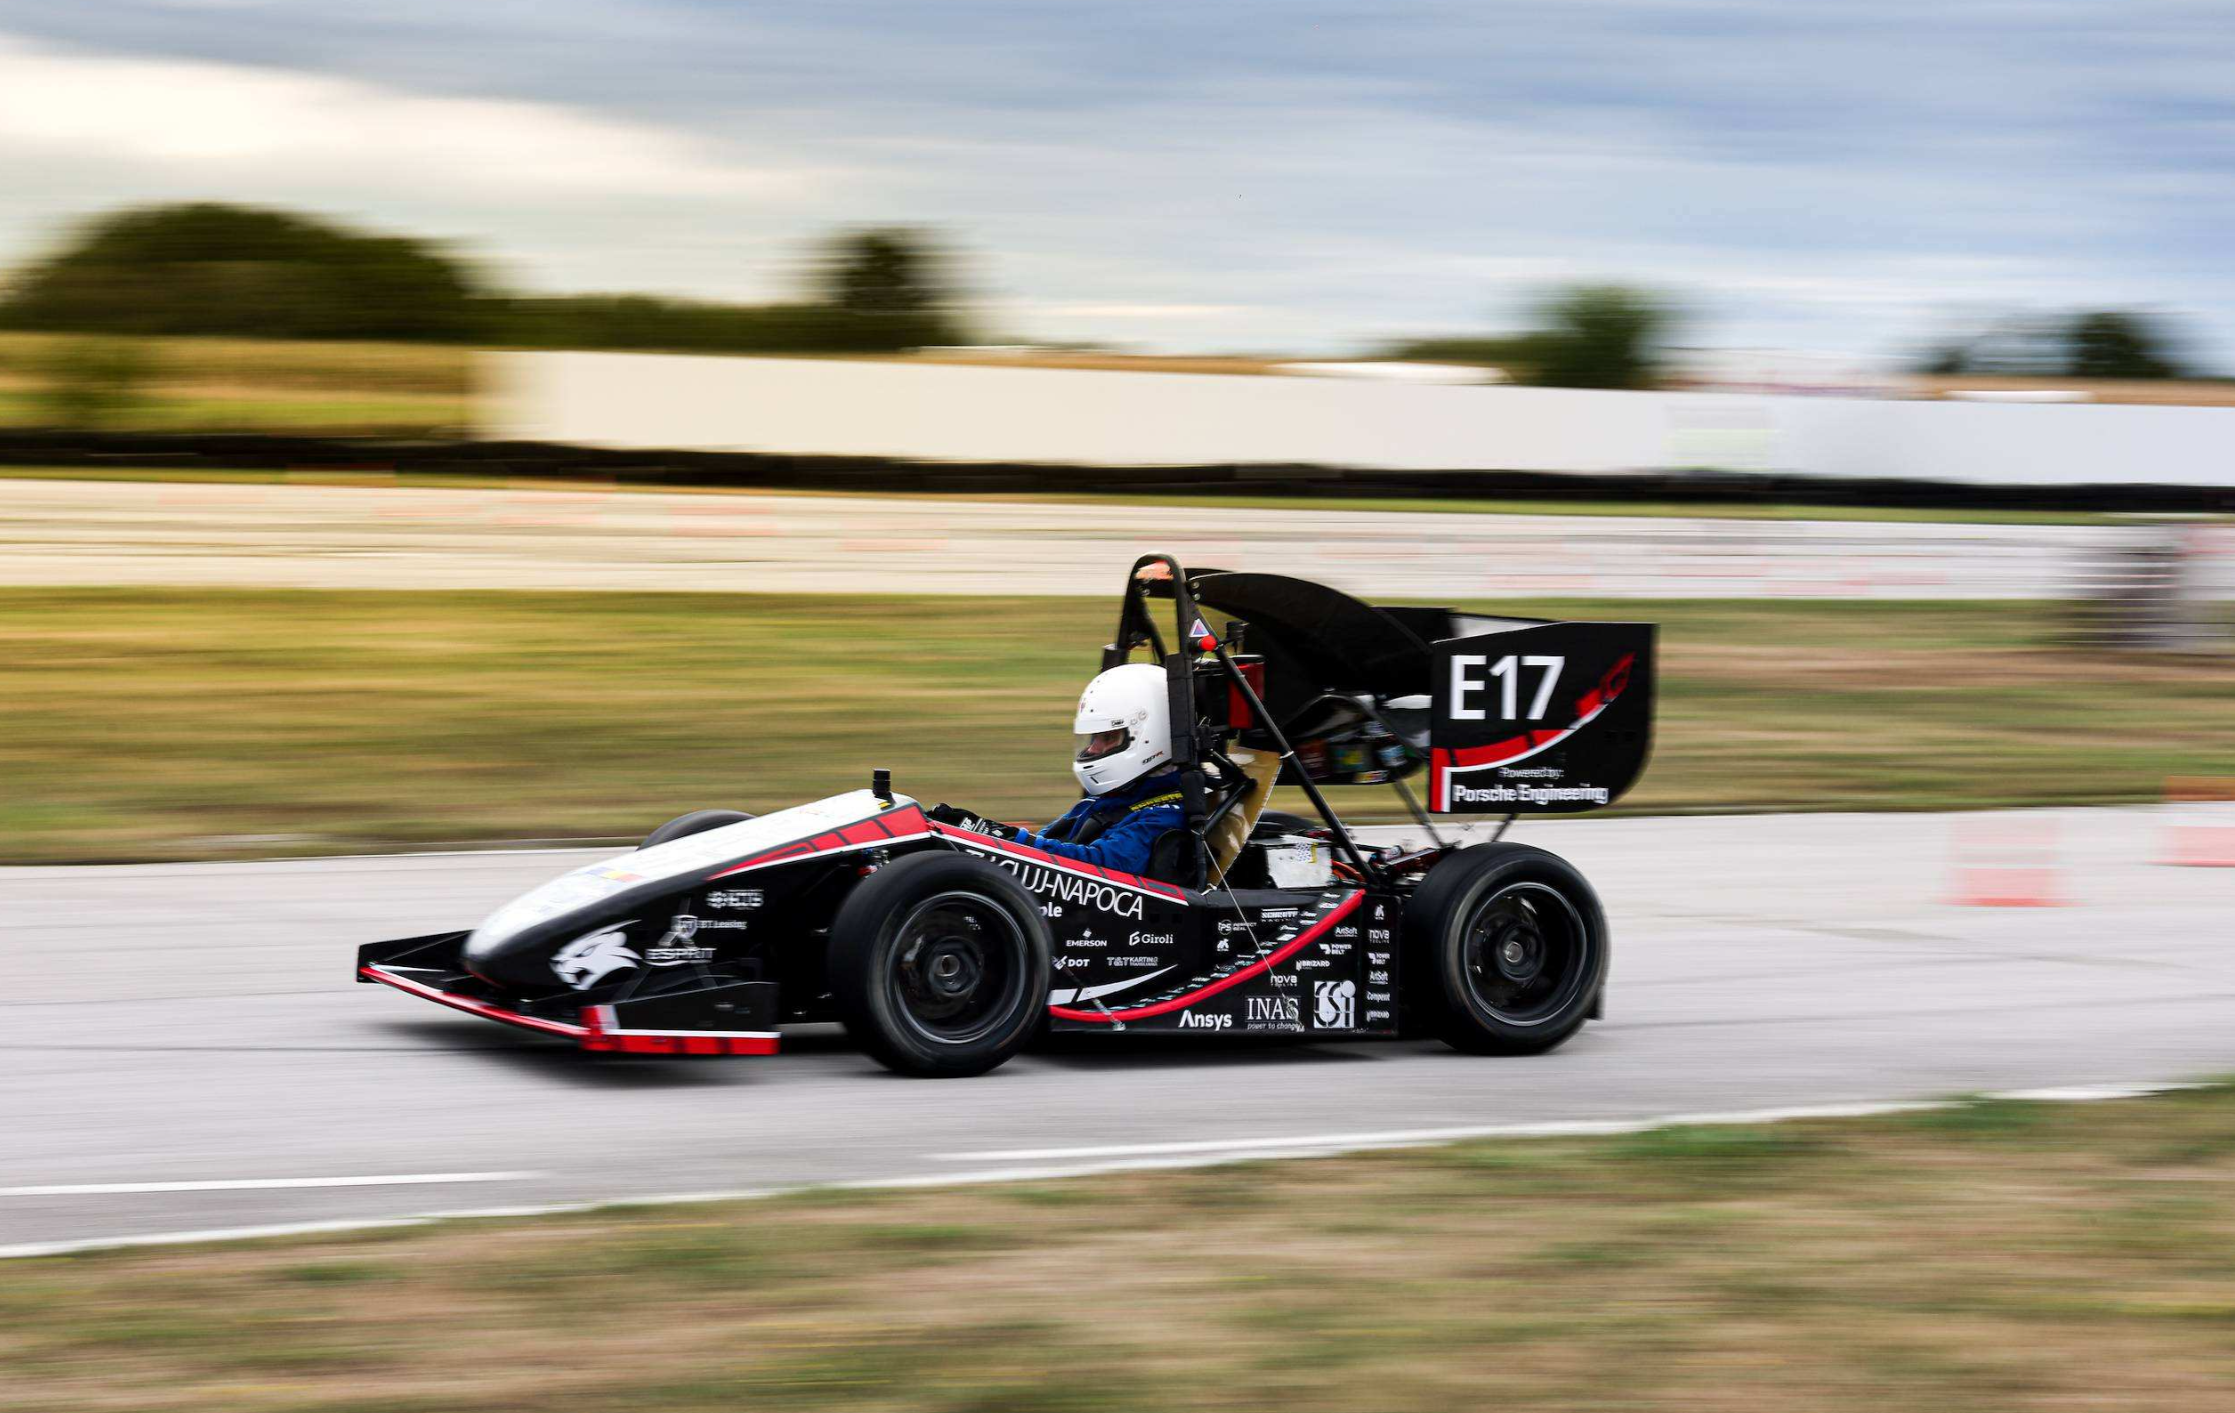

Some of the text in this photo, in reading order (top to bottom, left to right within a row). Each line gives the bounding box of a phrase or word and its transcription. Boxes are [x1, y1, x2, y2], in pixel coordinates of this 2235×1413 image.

[1450, 655, 1565, 720] E17
[1453, 783, 1609, 805] Porsche Engineering
[1141, 934, 1174, 944] Giroli
[1369, 929, 1390, 939] nova
[1068, 958, 1090, 967] DOT
[1107, 957, 1130, 967] T&T
[1302, 960, 1330, 968] BRIZARD
[1270, 974, 1298, 983] nova
[1247, 998, 1300, 1020] INAS
[1178, 1009, 1232, 1031] Ansys
[1247, 1021, 1302, 1031] power to chang
